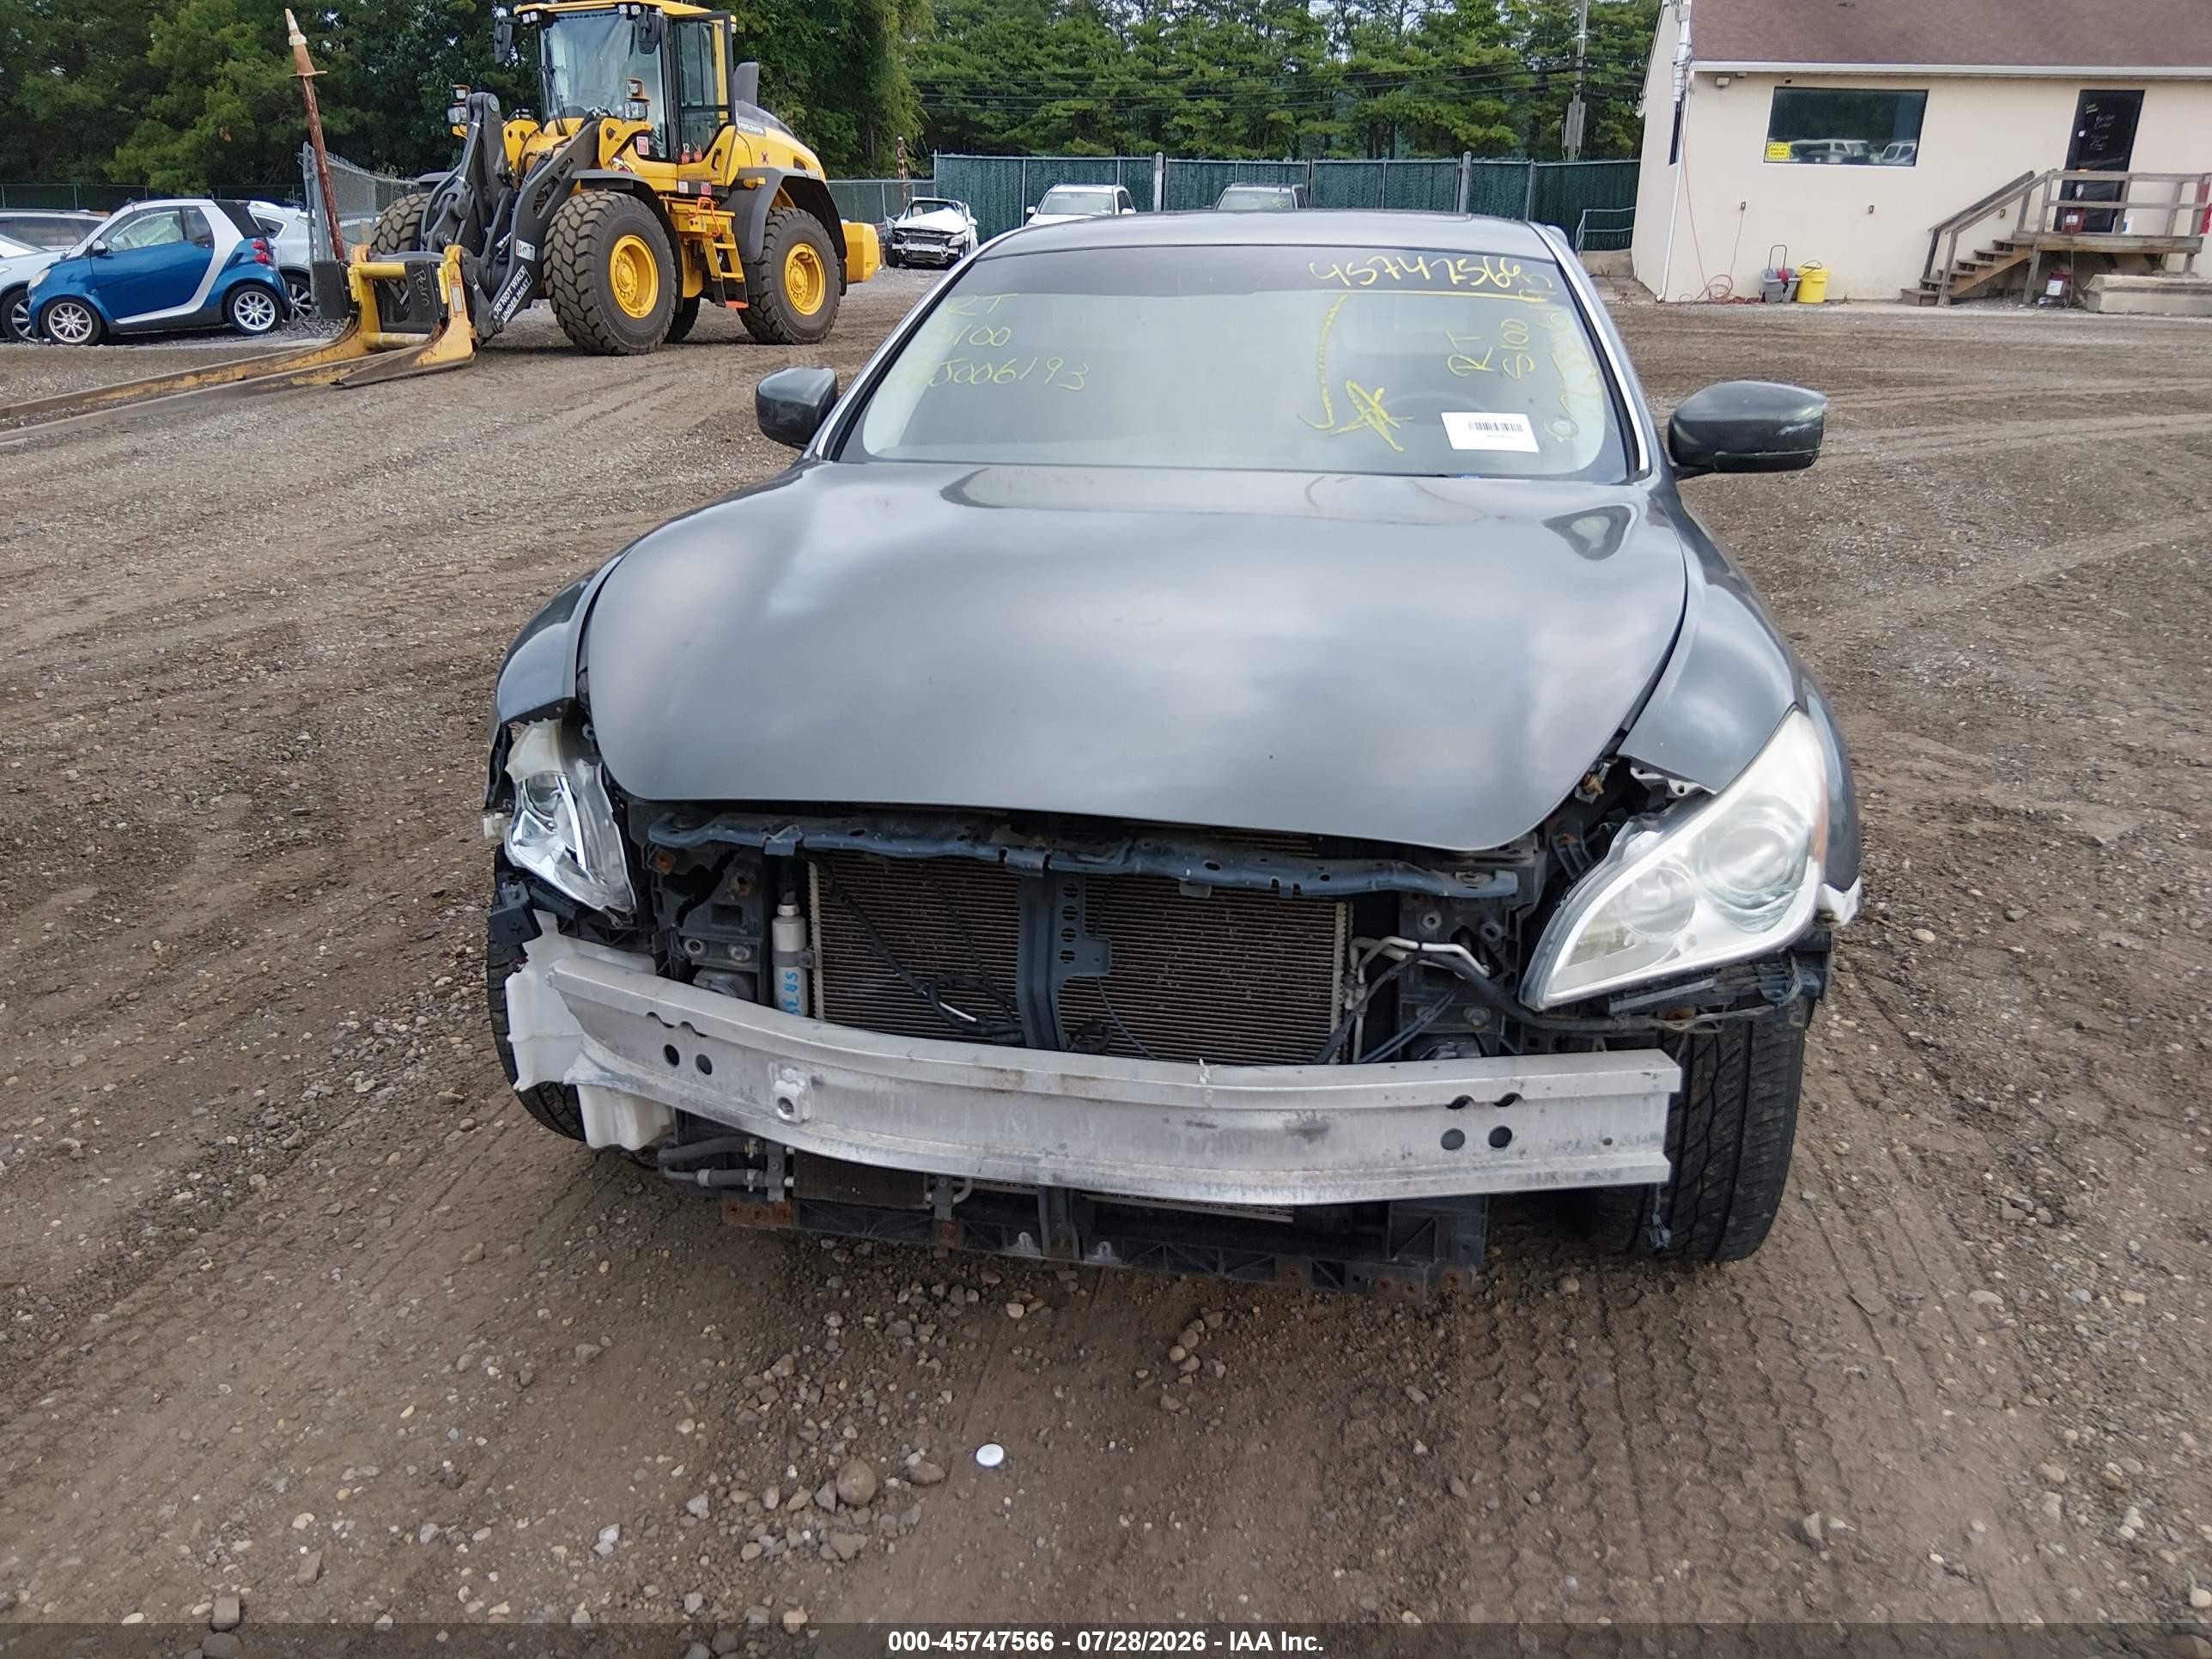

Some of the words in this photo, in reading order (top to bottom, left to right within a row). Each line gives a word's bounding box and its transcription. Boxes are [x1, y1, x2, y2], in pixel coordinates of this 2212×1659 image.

[500, 287, 514, 305] NOT
[510, 268, 526, 289] WALK
[501, 297, 518, 322] UNDER
[1446, 330, 1494, 377] RT
